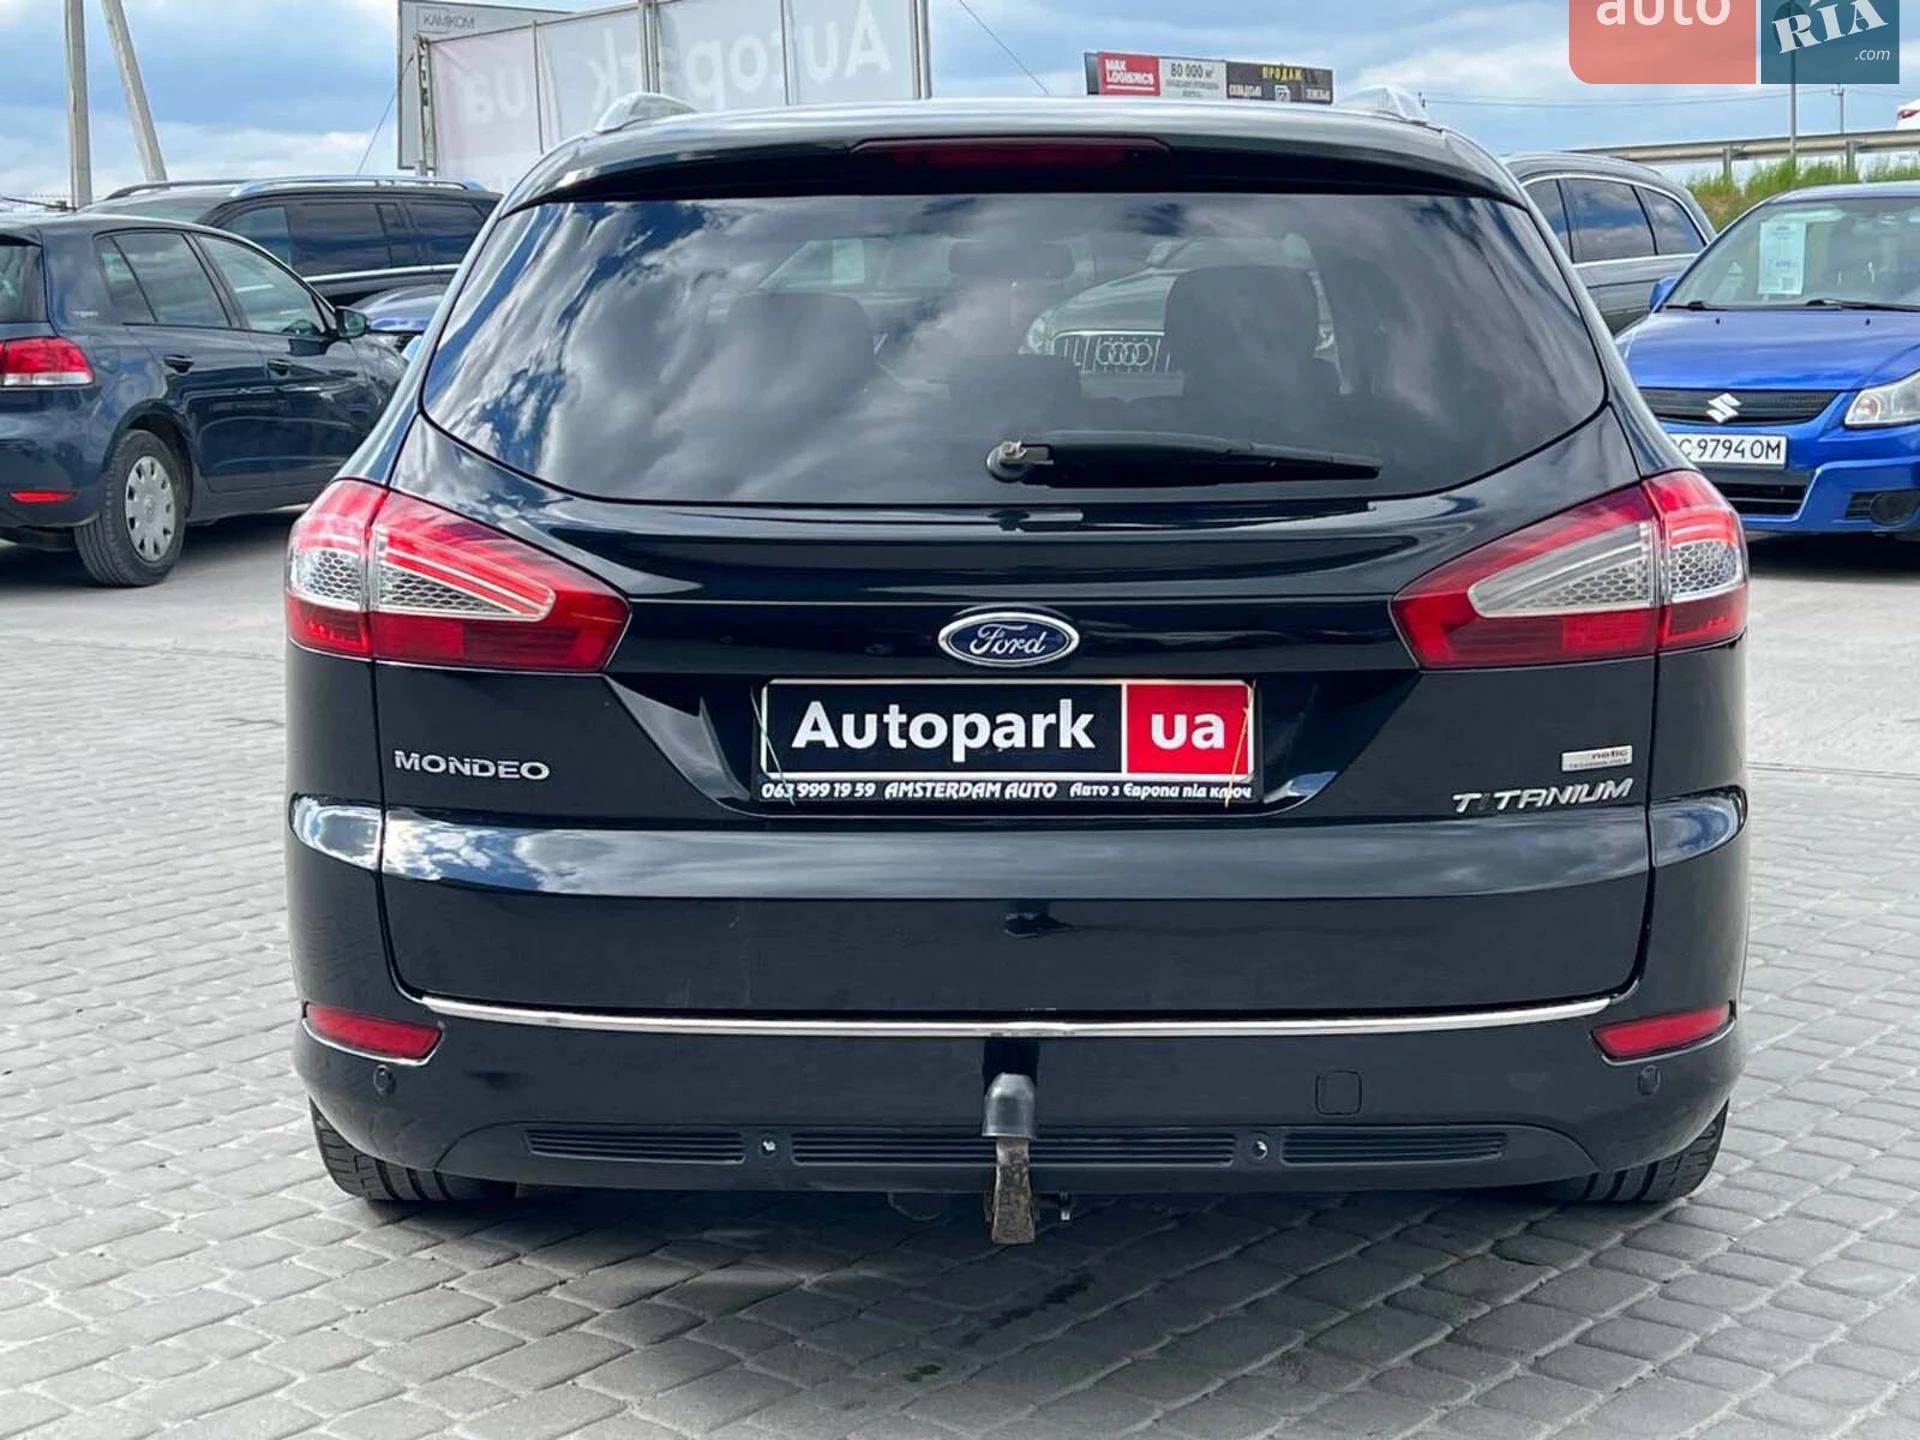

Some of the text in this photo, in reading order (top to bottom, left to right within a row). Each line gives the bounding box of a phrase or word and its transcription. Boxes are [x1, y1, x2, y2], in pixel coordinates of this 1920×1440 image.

[1697, 438, 1746, 459] 9794
[969, 623, 1048, 655] Ford
[791, 699, 1225, 763] Autopark ua
[394, 750, 550, 780] MONDEO
[761, 782, 795, 799] 063
[796, 782, 830, 798] 999
[833, 782, 852, 798] 19
[854, 782, 876, 798] 59
[884, 781, 1003, 800] AMSTERDAM
[1004, 781, 1057, 799] AUTO
